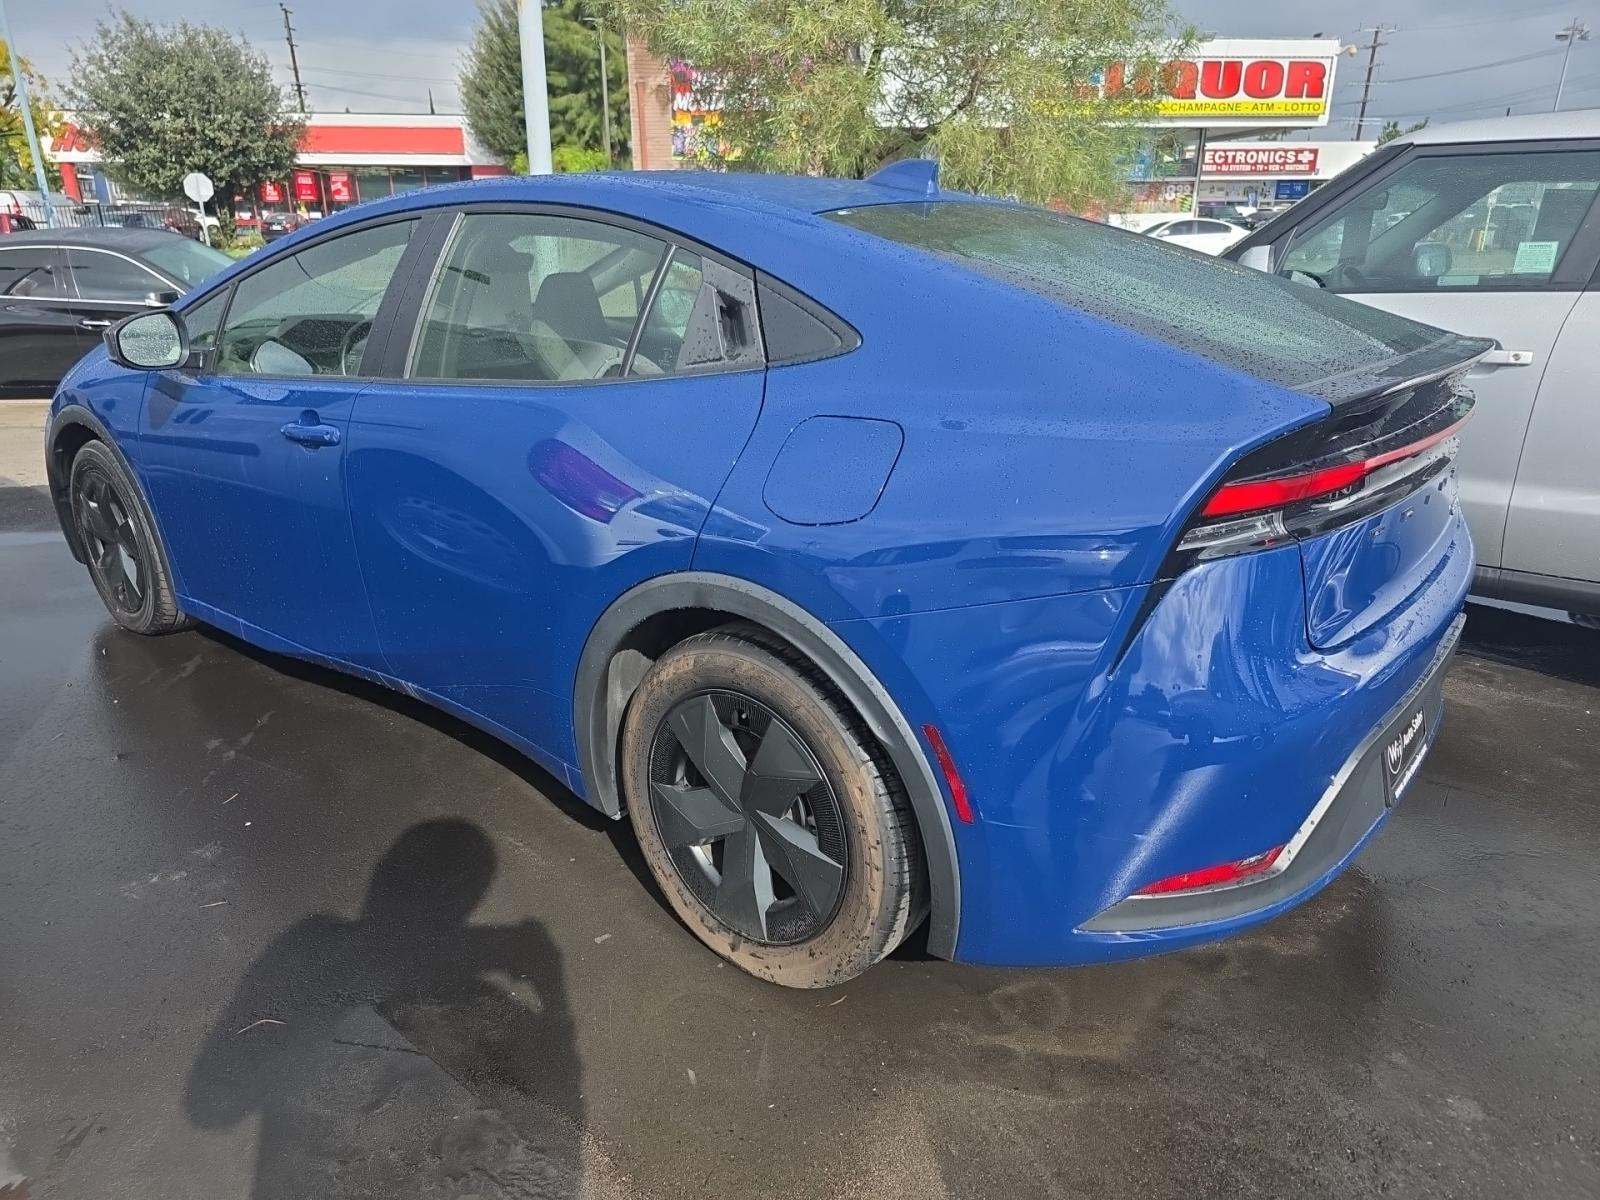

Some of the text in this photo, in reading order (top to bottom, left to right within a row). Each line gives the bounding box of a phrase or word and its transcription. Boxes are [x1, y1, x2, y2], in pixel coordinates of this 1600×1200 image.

[1170, 102, 1242, 112] CHAMPAGNE
[1251, 102, 1275, 112] ATM
[1284, 102, 1321, 112] LOTTO
